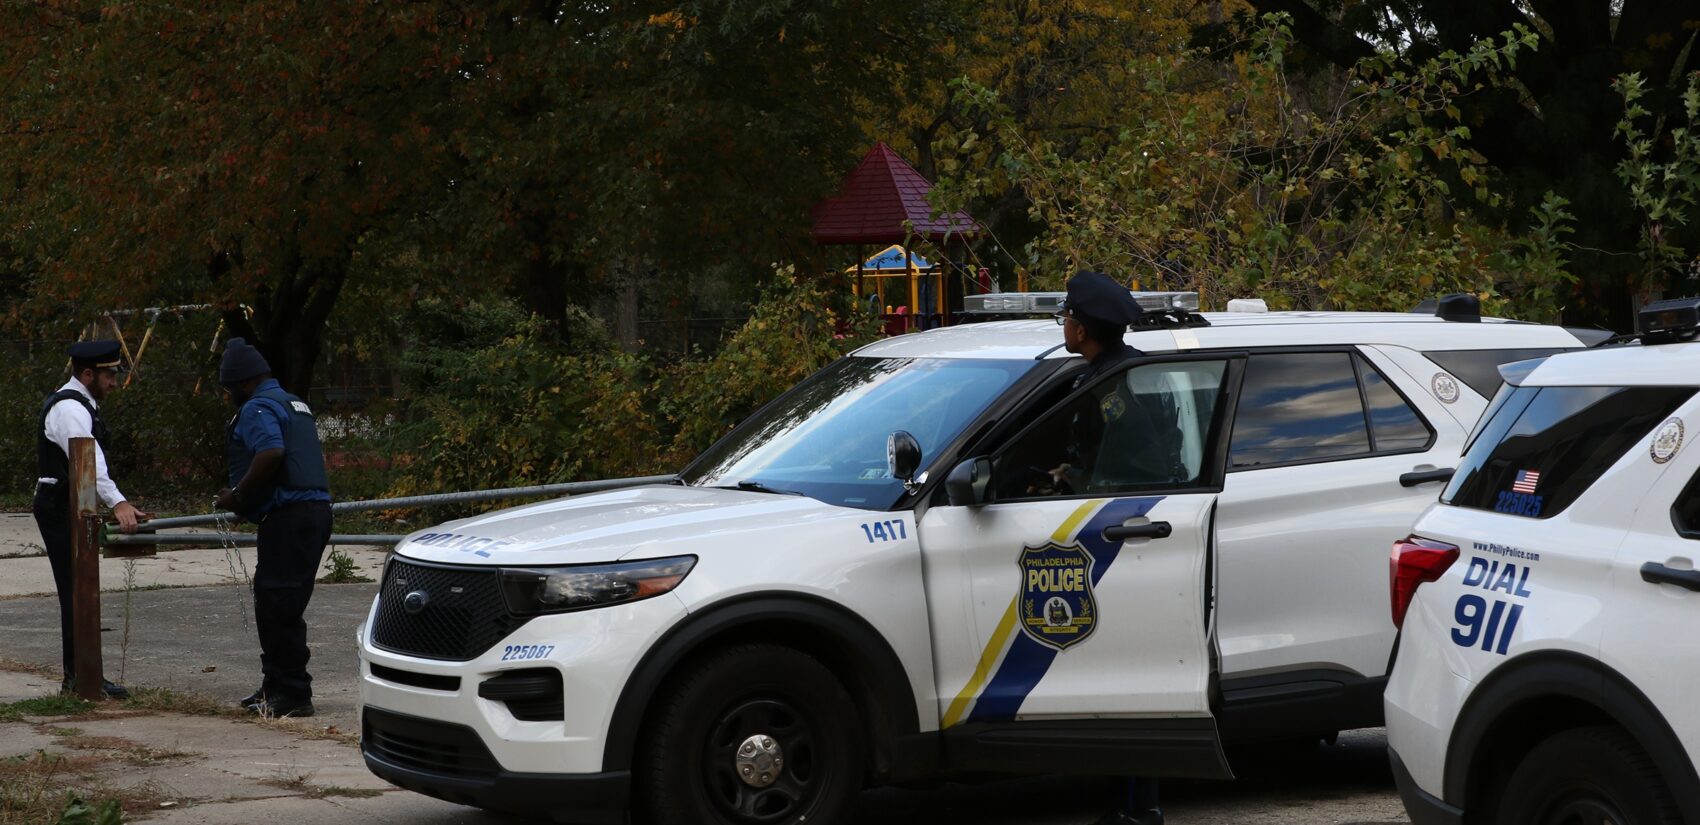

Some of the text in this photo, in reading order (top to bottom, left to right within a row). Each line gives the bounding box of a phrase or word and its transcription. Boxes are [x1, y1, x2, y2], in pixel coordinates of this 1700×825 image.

[1495, 490, 1543, 517] 225025
[861, 519, 907, 543] 1417
[411, 533, 511, 558] POLICE
[1473, 542, 1540, 561] www.PhillyPolice.com
[1026, 558, 1084, 567] PHILADELPHIA
[1028, 568, 1084, 593] POLICE
[1462, 556, 1531, 598] DIAL
[1451, 594, 1524, 656] 911
[502, 645, 555, 661] 225087
